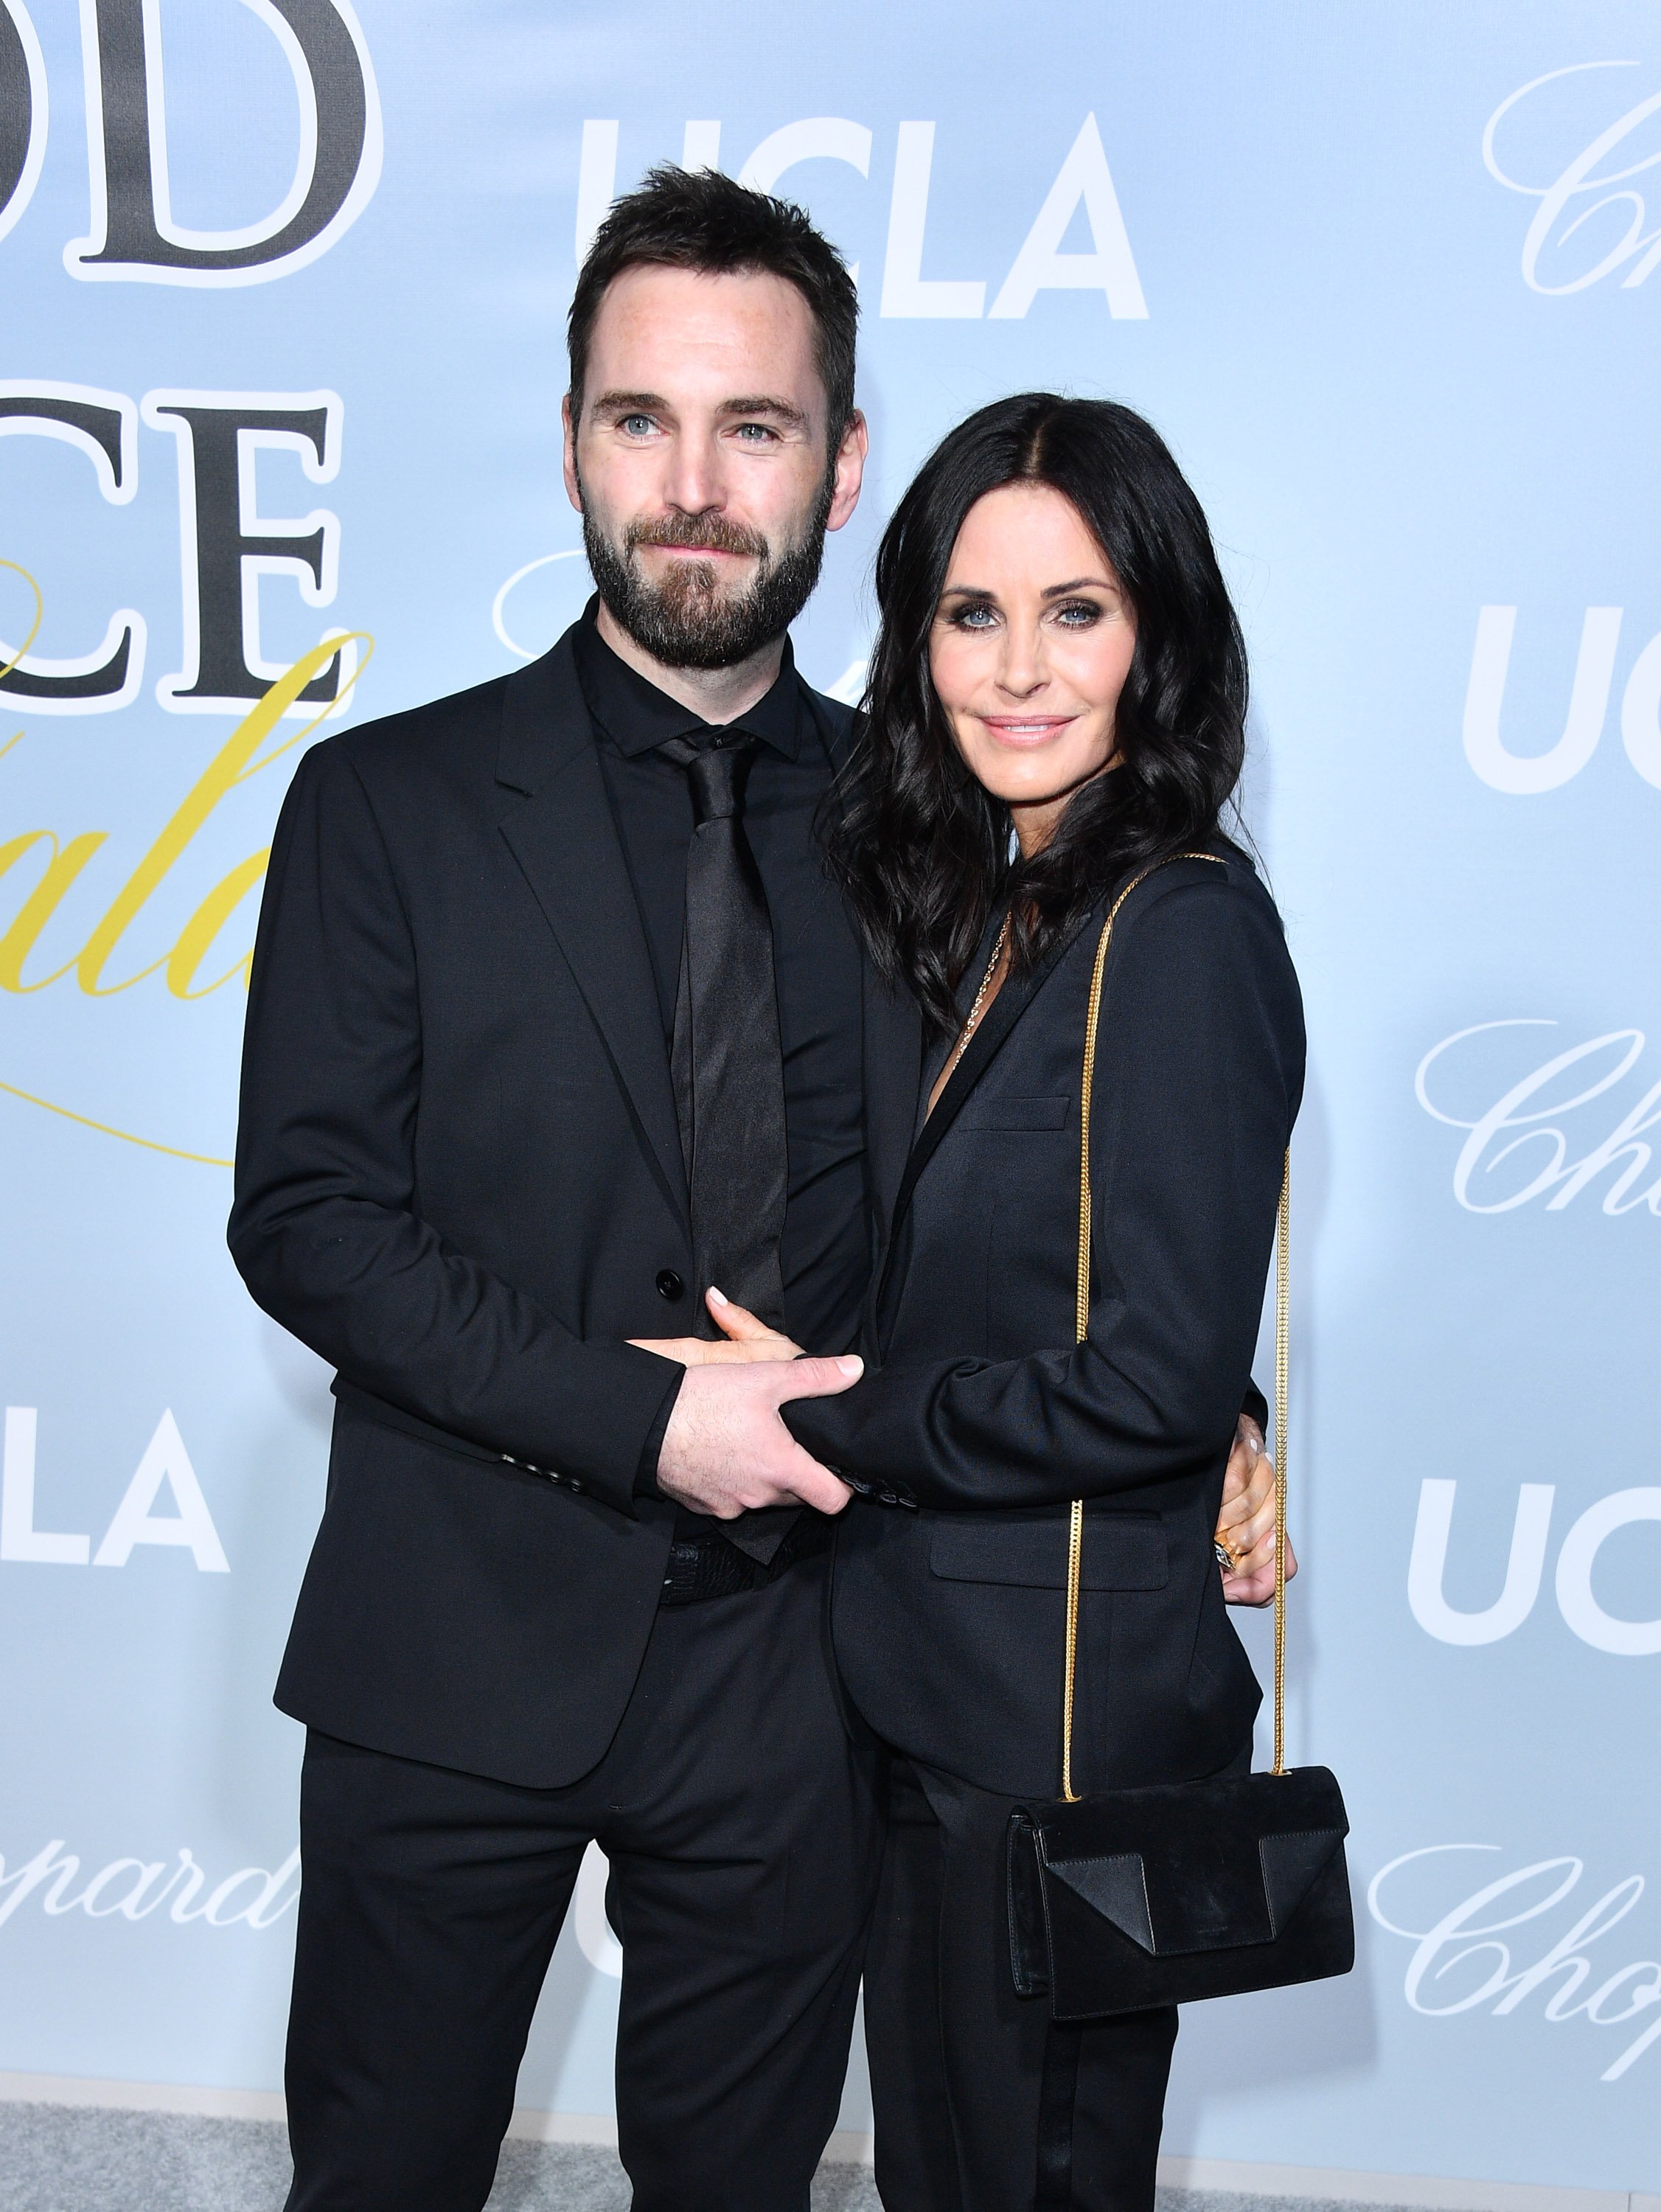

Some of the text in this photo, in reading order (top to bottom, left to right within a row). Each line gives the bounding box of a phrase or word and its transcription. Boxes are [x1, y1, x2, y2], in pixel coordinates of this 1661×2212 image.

[0, 0, 375, 279] D
[1483, 60, 1661, 295] C
[1463, 605, 1661, 795] U
[1415, 1018, 1661, 1217] Ch
[0, 1406, 231, 1573] LA
[0, 1840, 301, 1929] pard
